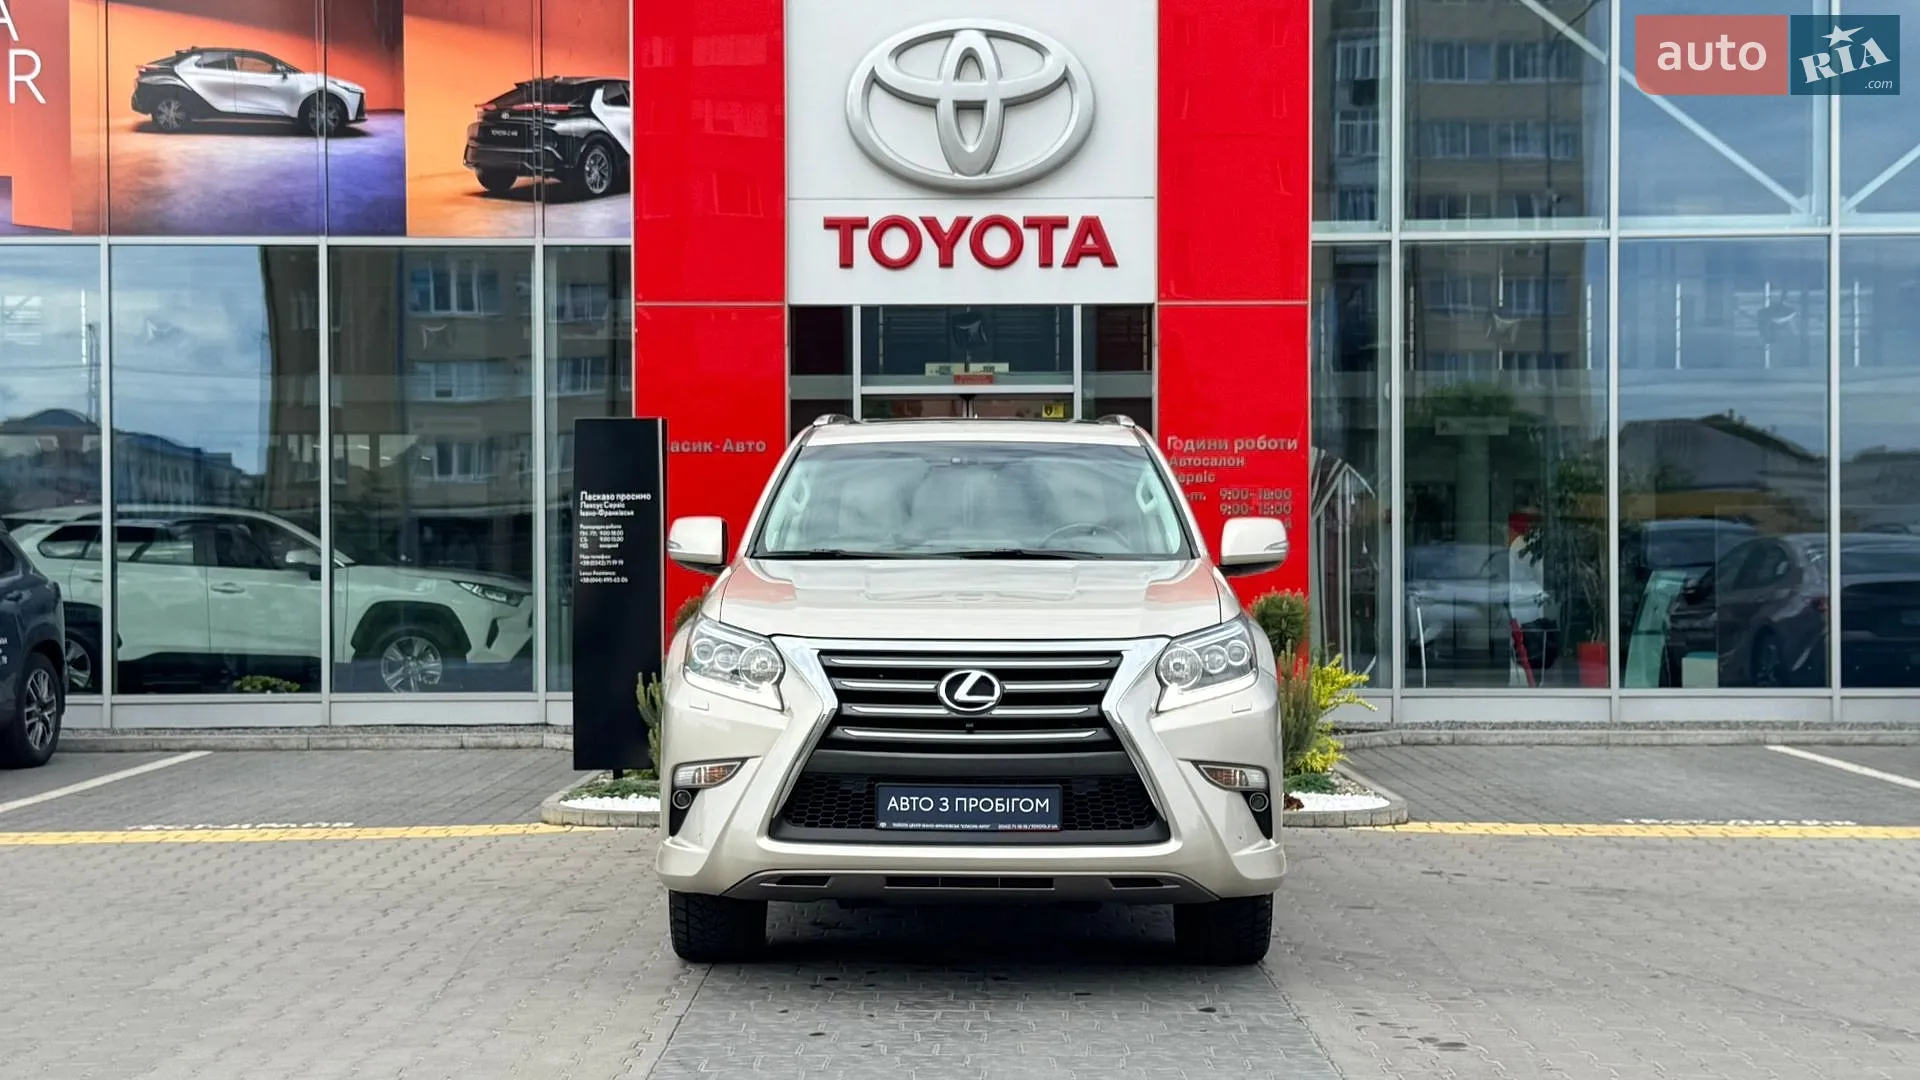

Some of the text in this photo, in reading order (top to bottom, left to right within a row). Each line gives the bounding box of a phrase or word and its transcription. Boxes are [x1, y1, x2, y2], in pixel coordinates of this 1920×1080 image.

[823, 214, 1119, 270] TOYOTA
[668, 438, 767, 454] асик-Авто
[1167, 434, 1298, 453] Години роботи
[1168, 455, 1245, 467] Автосалон
[1175, 471, 1216, 485] ервіс
[887, 796, 934, 812] АВТО
[955, 797, 1050, 812] ПРОБІГОМ
